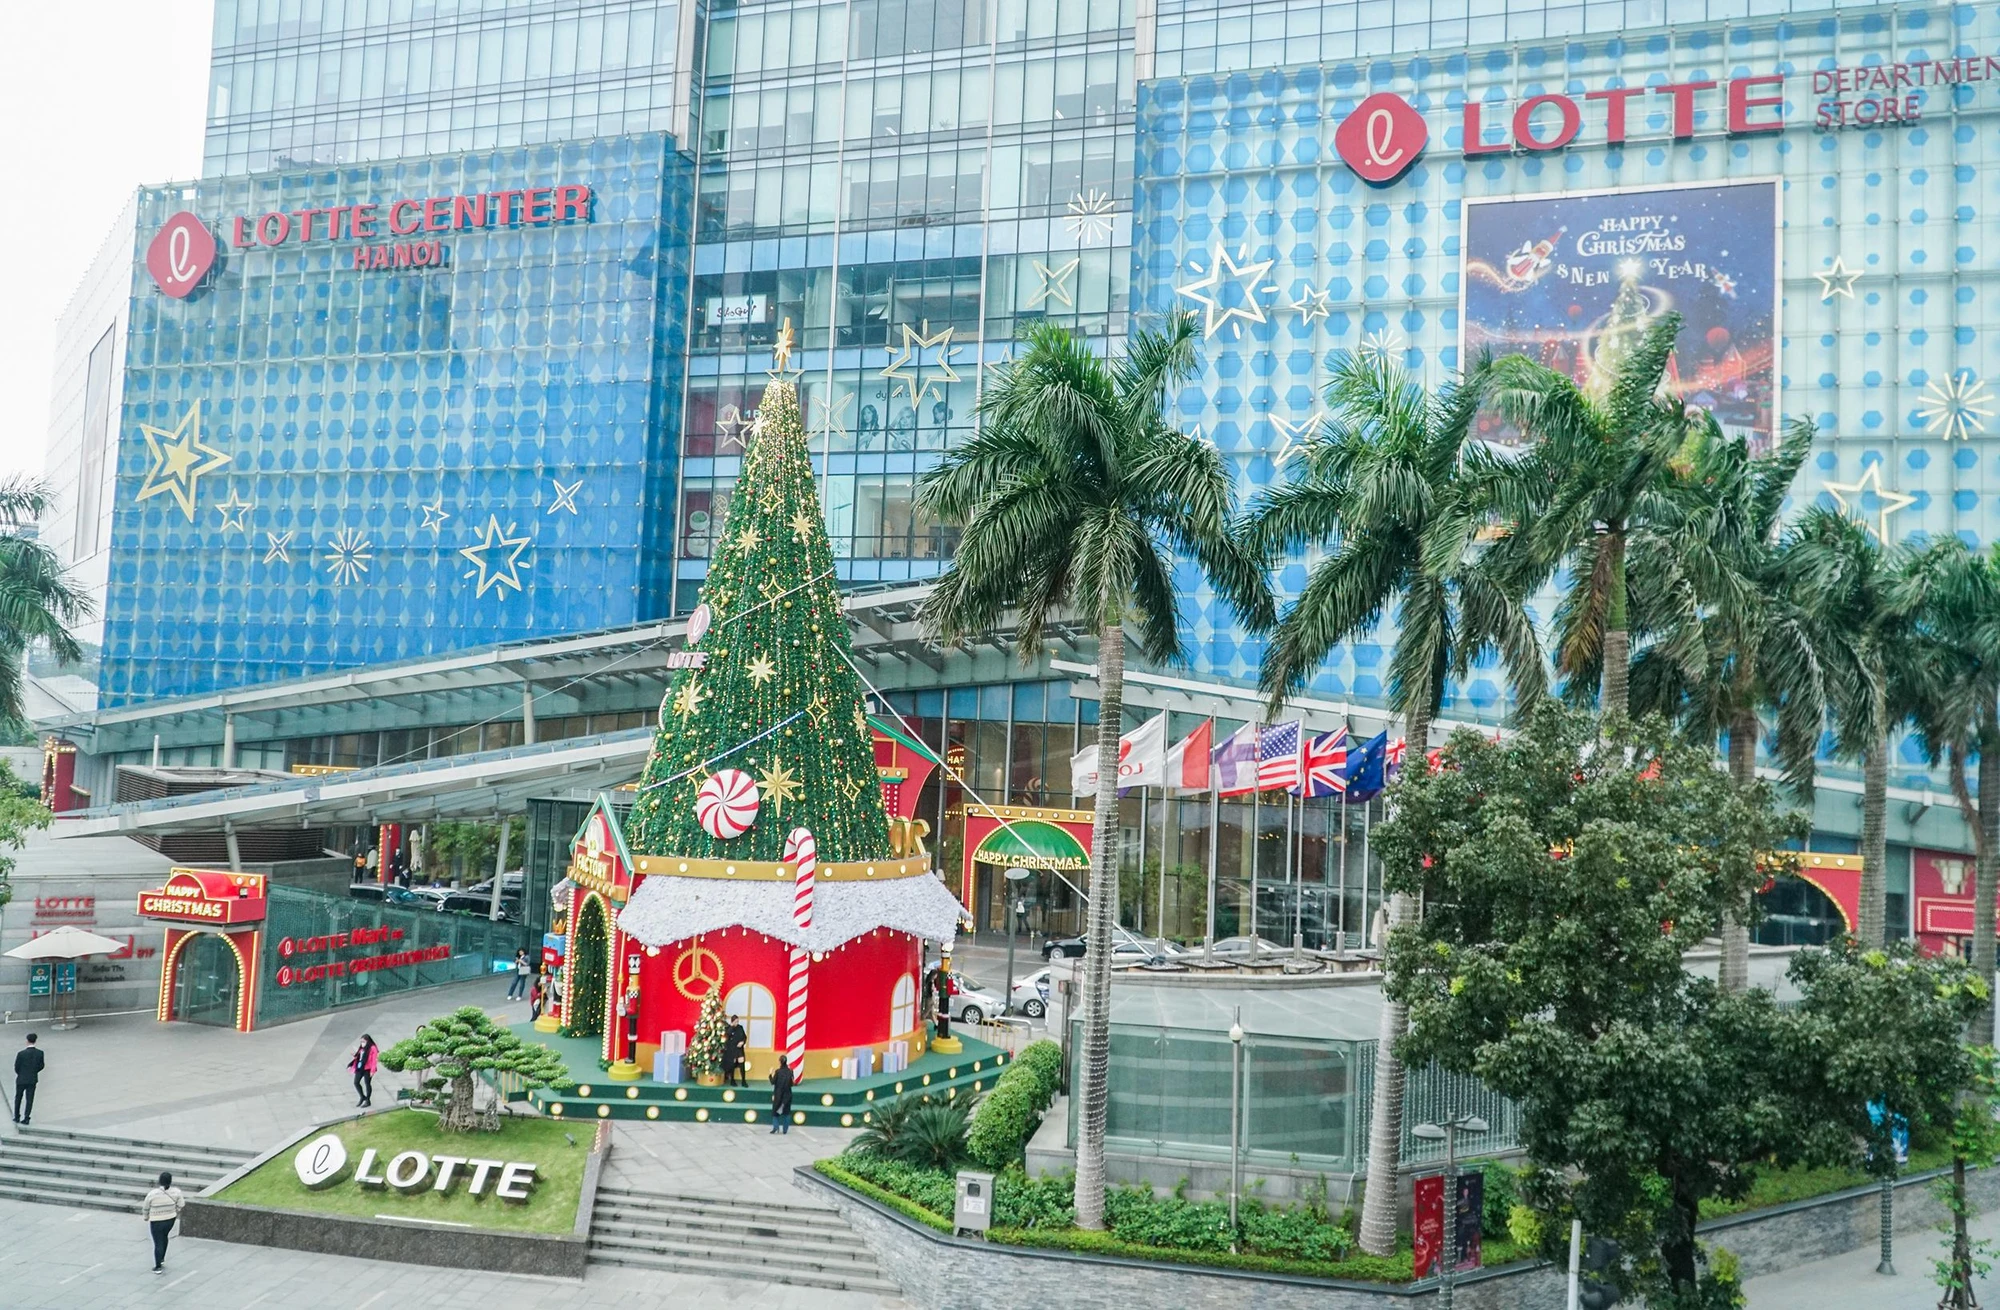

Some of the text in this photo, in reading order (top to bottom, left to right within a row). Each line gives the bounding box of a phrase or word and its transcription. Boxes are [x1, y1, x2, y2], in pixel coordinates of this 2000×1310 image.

[1463, 75, 1784, 155] LOTTE
[1816, 95, 1921, 127] STORE
[232, 184, 590, 249] LOTTE CENTER
[1599, 215, 1664, 232] HAPPY
[353, 240, 443, 272] HANOI
[875, 390, 903, 401] dyn
[666, 651, 709, 669] LOTTE
[978, 849, 1082, 870] HAPPY CHRISTMAS
[166, 885, 201, 899] HAPPY
[34, 896, 95, 910] LOTTE
[144, 898, 223, 918] CHRISTMAS
[296, 933, 349, 953] LOTTE
[351, 924, 390, 946] Mart
[294, 962, 346, 983] LOTTE
[354, 1148, 537, 1199] LOTTE
